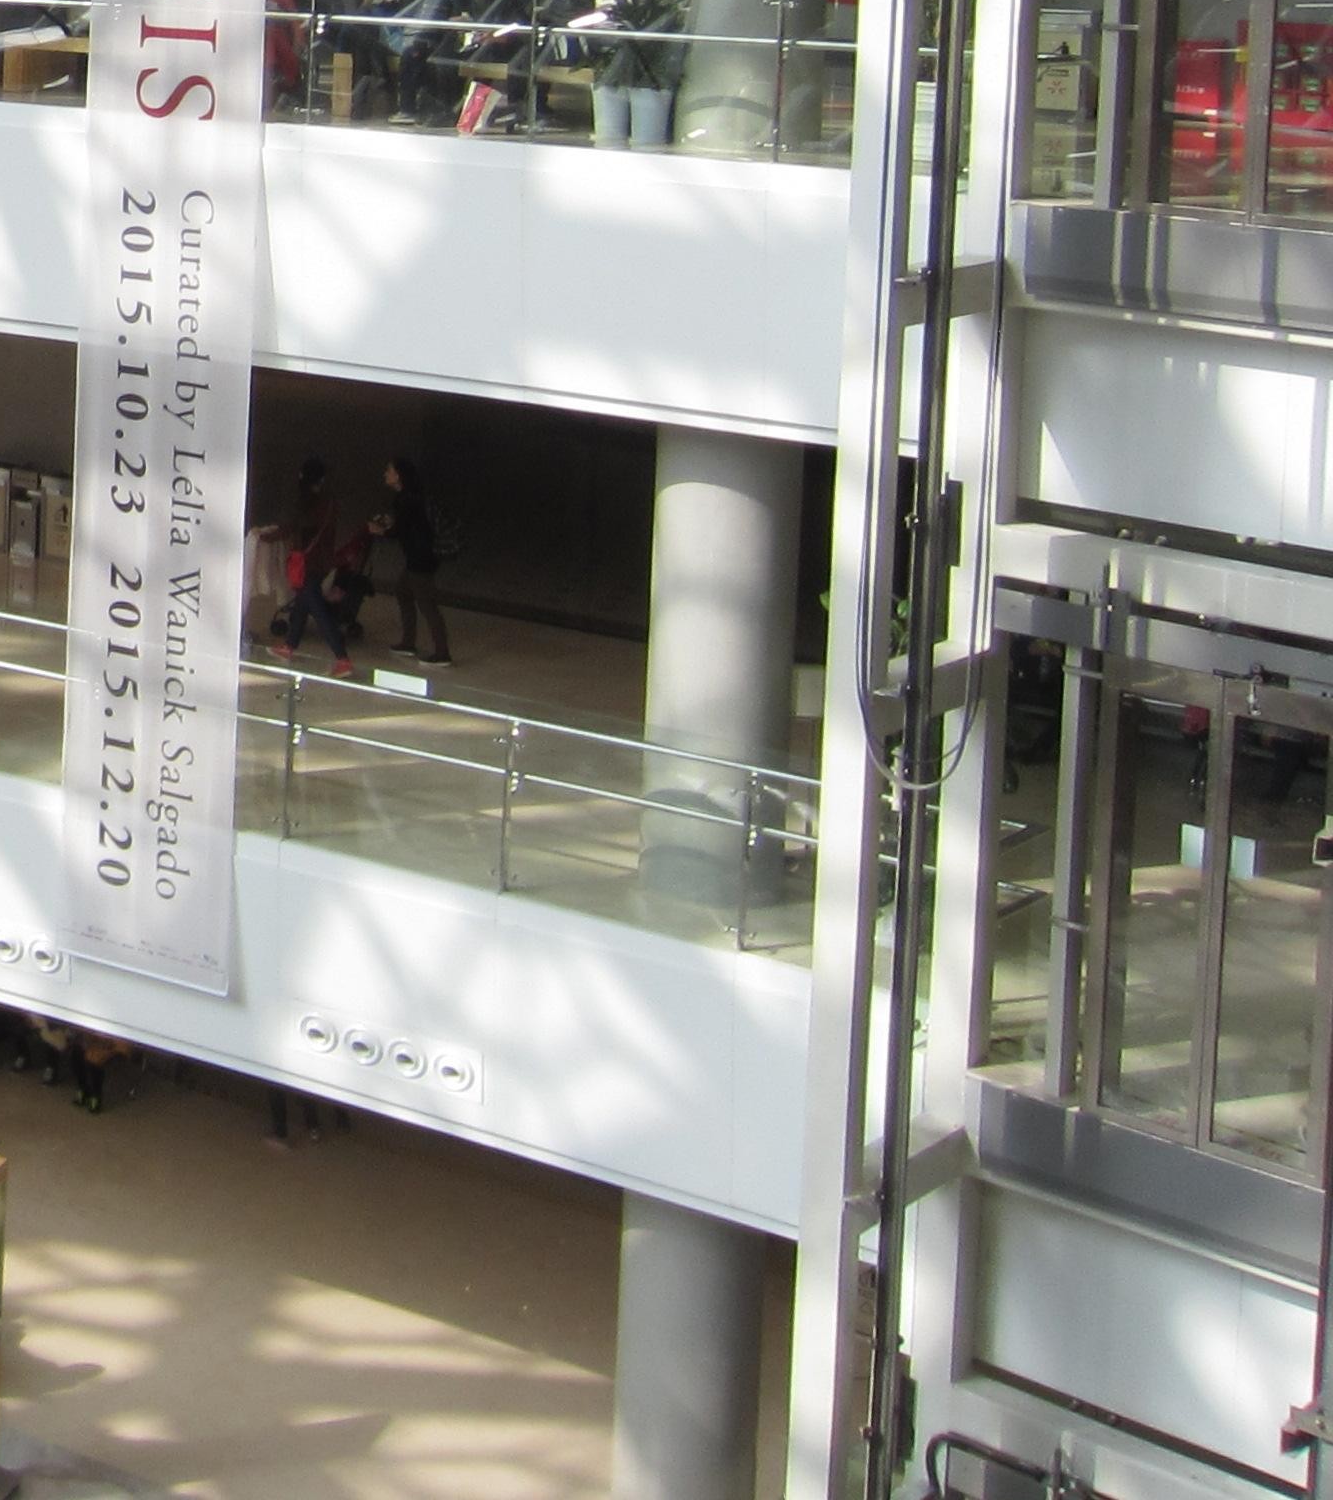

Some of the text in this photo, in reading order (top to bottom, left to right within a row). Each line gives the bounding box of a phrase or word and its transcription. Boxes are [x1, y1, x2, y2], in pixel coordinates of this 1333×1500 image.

[97, 187, 157, 887] 2015.10.23 2015.12.20
[146, 189, 214, 900] Curated by Lélia Wanick Salgado
